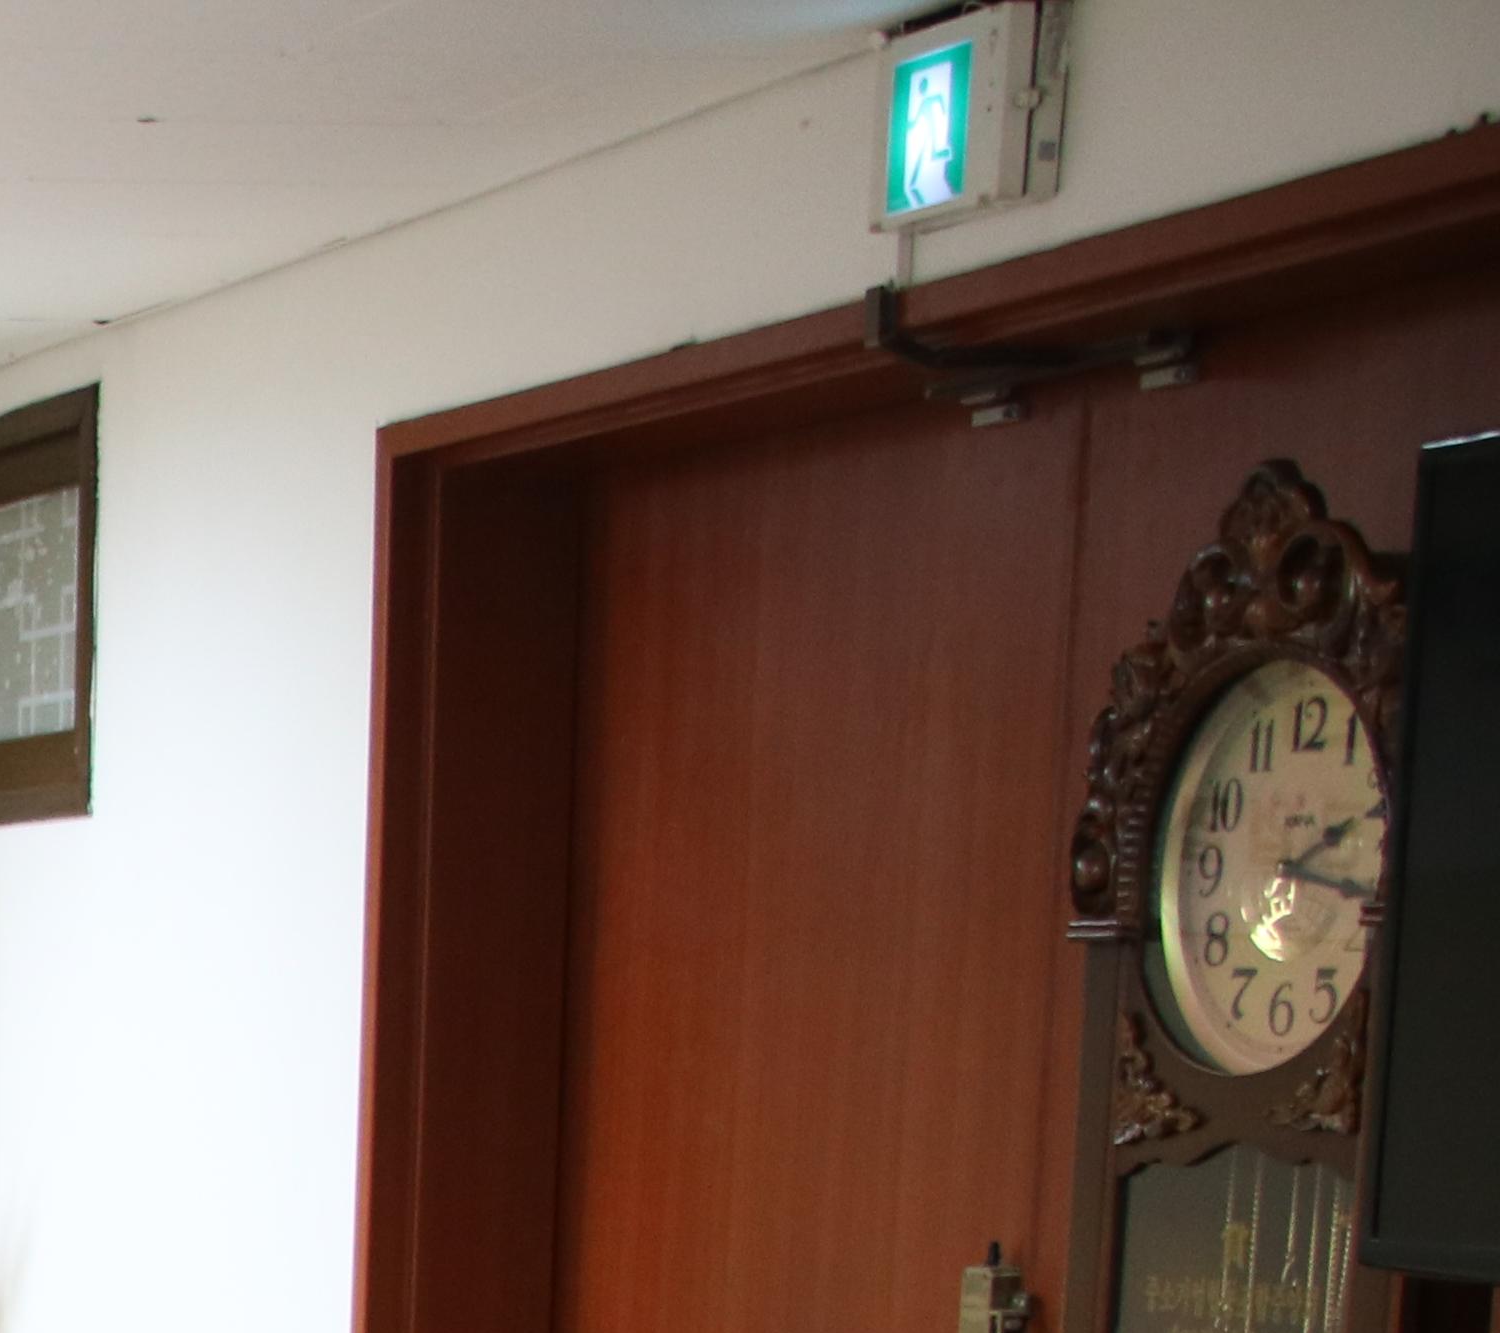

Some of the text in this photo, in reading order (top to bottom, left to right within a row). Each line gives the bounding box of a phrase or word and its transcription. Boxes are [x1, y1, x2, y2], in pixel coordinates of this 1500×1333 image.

[1250, 720, 1275, 773] 11
[1292, 697, 1326, 752] 12
[1209, 777, 1243, 832] 10
[1200, 847, 1223, 897] 9
[1205, 913, 1229, 966] 8
[1231, 968, 1257, 1019] 7
[1270, 984, 1294, 1036] 6
[1310, 968, 1337, 1024] 5
